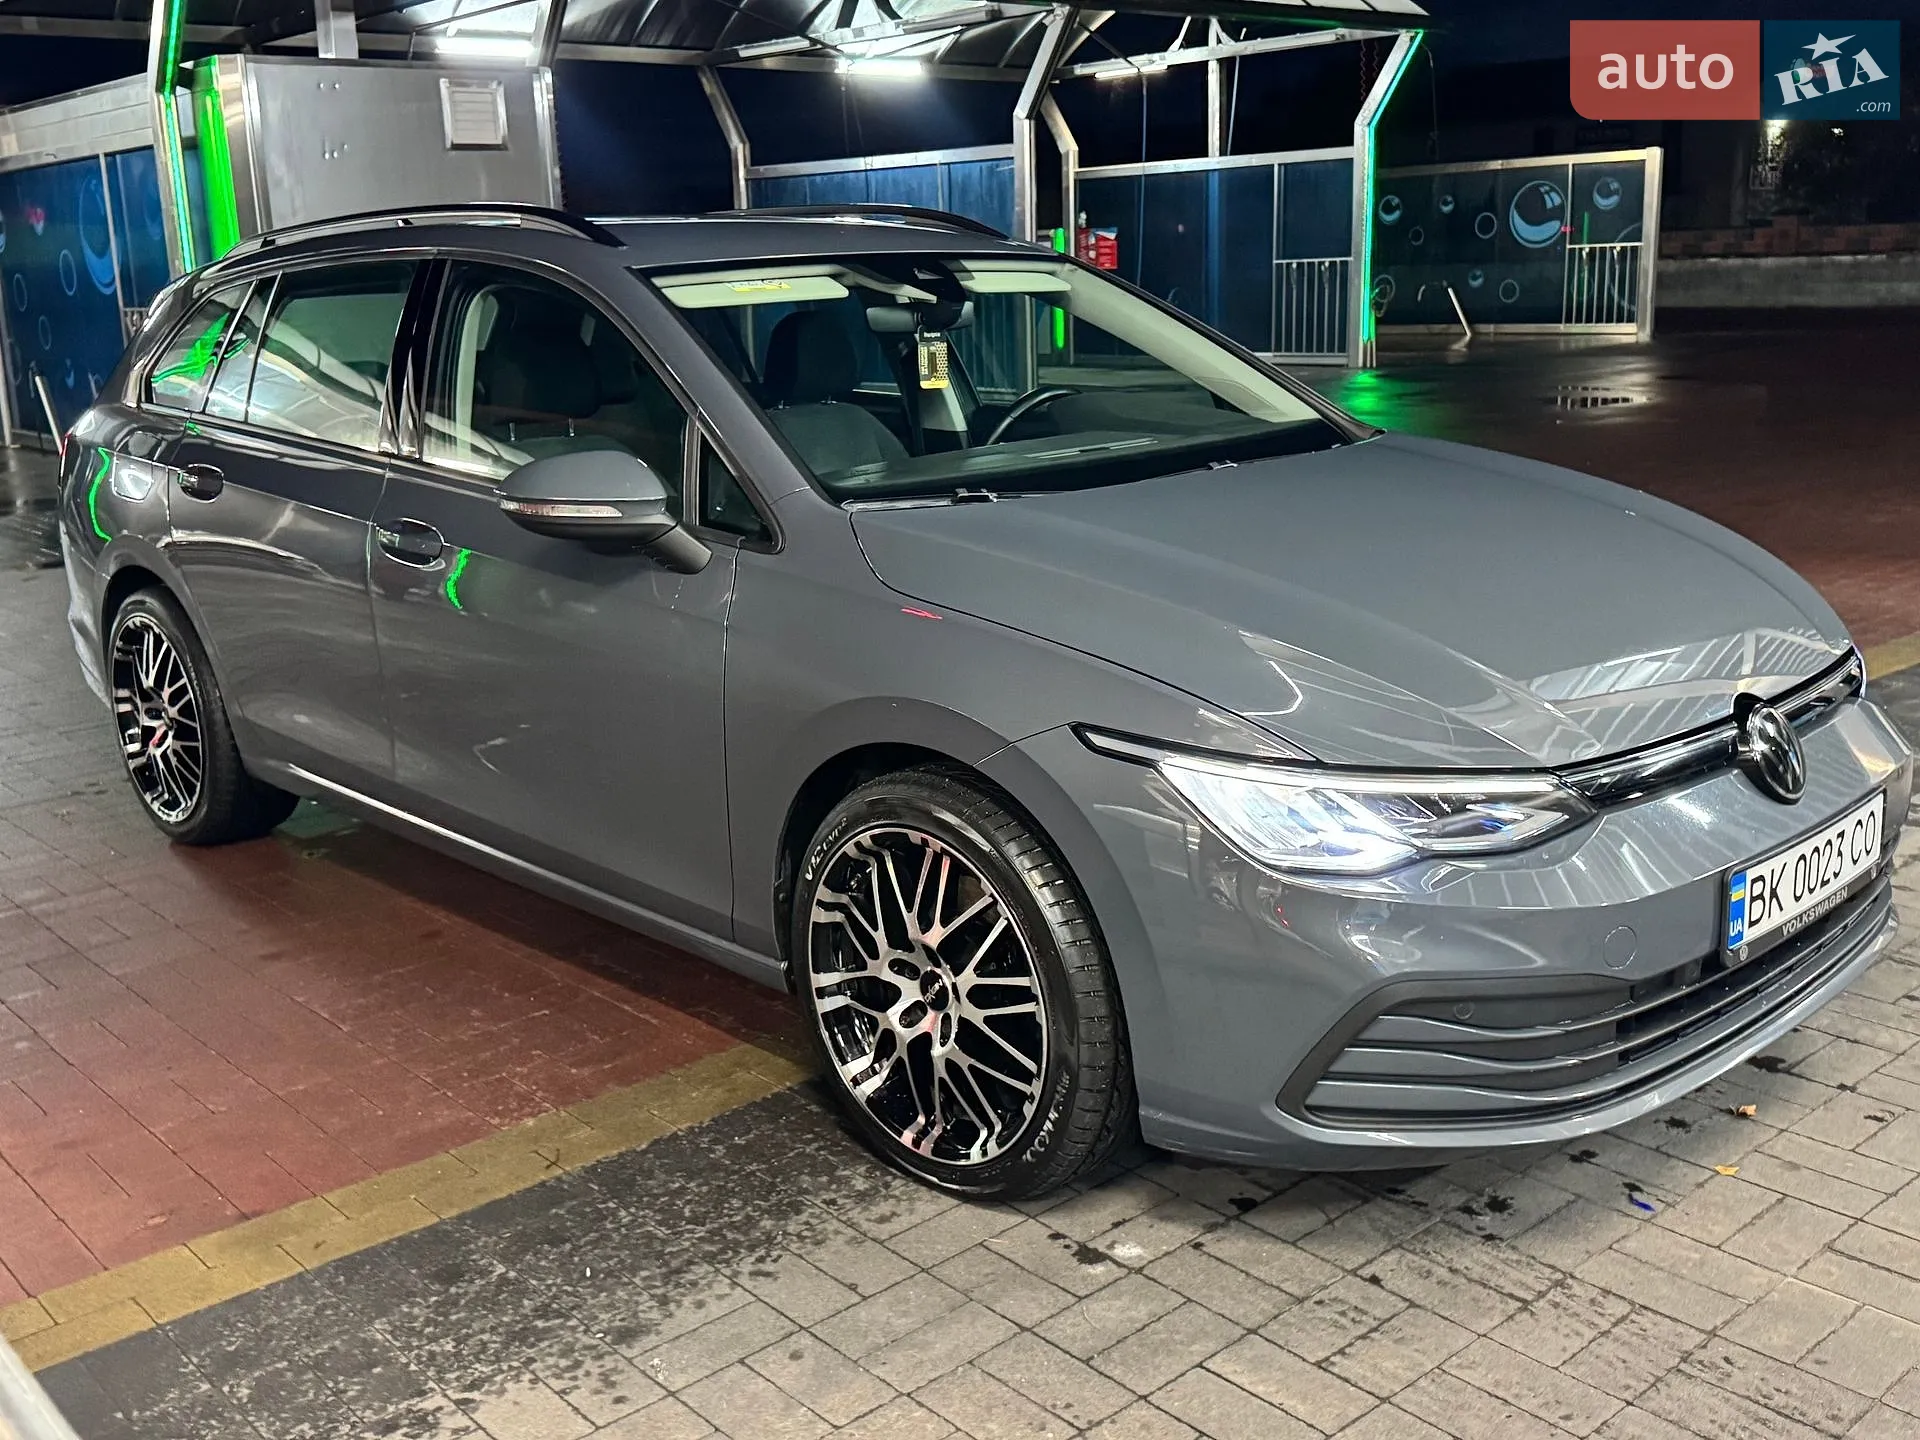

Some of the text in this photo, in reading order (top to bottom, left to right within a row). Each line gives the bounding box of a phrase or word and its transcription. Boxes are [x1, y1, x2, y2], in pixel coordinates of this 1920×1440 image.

[1748, 809, 1876, 930] BK 0023 CO
[1729, 917, 1743, 937] UA
[1781, 886, 1849, 937] VOLKSWAGEN
